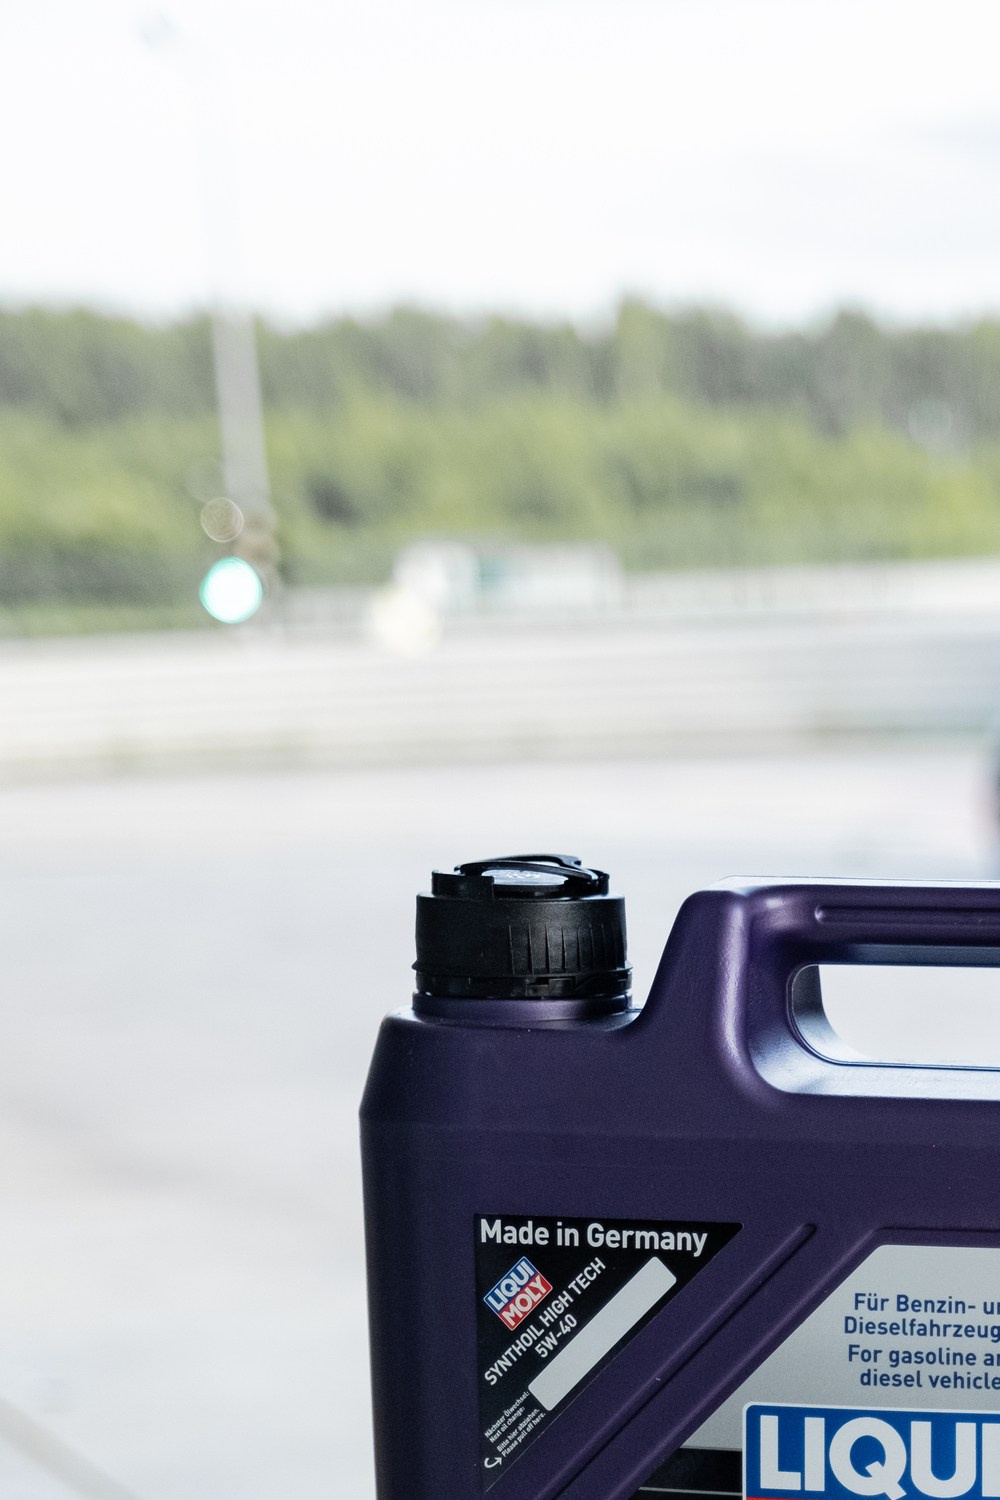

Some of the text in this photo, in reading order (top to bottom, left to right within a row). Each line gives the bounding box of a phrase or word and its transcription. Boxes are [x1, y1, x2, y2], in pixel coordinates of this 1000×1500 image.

[480, 1218, 708, 1257] Made in Germany
[487, 1261, 535, 1311] LIQUI
[501, 1275, 548, 1327] MOLY
[854, 1292, 889, 1313] Für
[896, 1294, 977, 1315] Benzin-
[484, 1257, 606, 1386] SYNTHOIL HIGH TECH
[535, 1313, 578, 1358] 5W-40
[848, 1345, 882, 1365] For
[888, 1346, 977, 1371] gasoline
[860, 1367, 923, 1388] diesel
